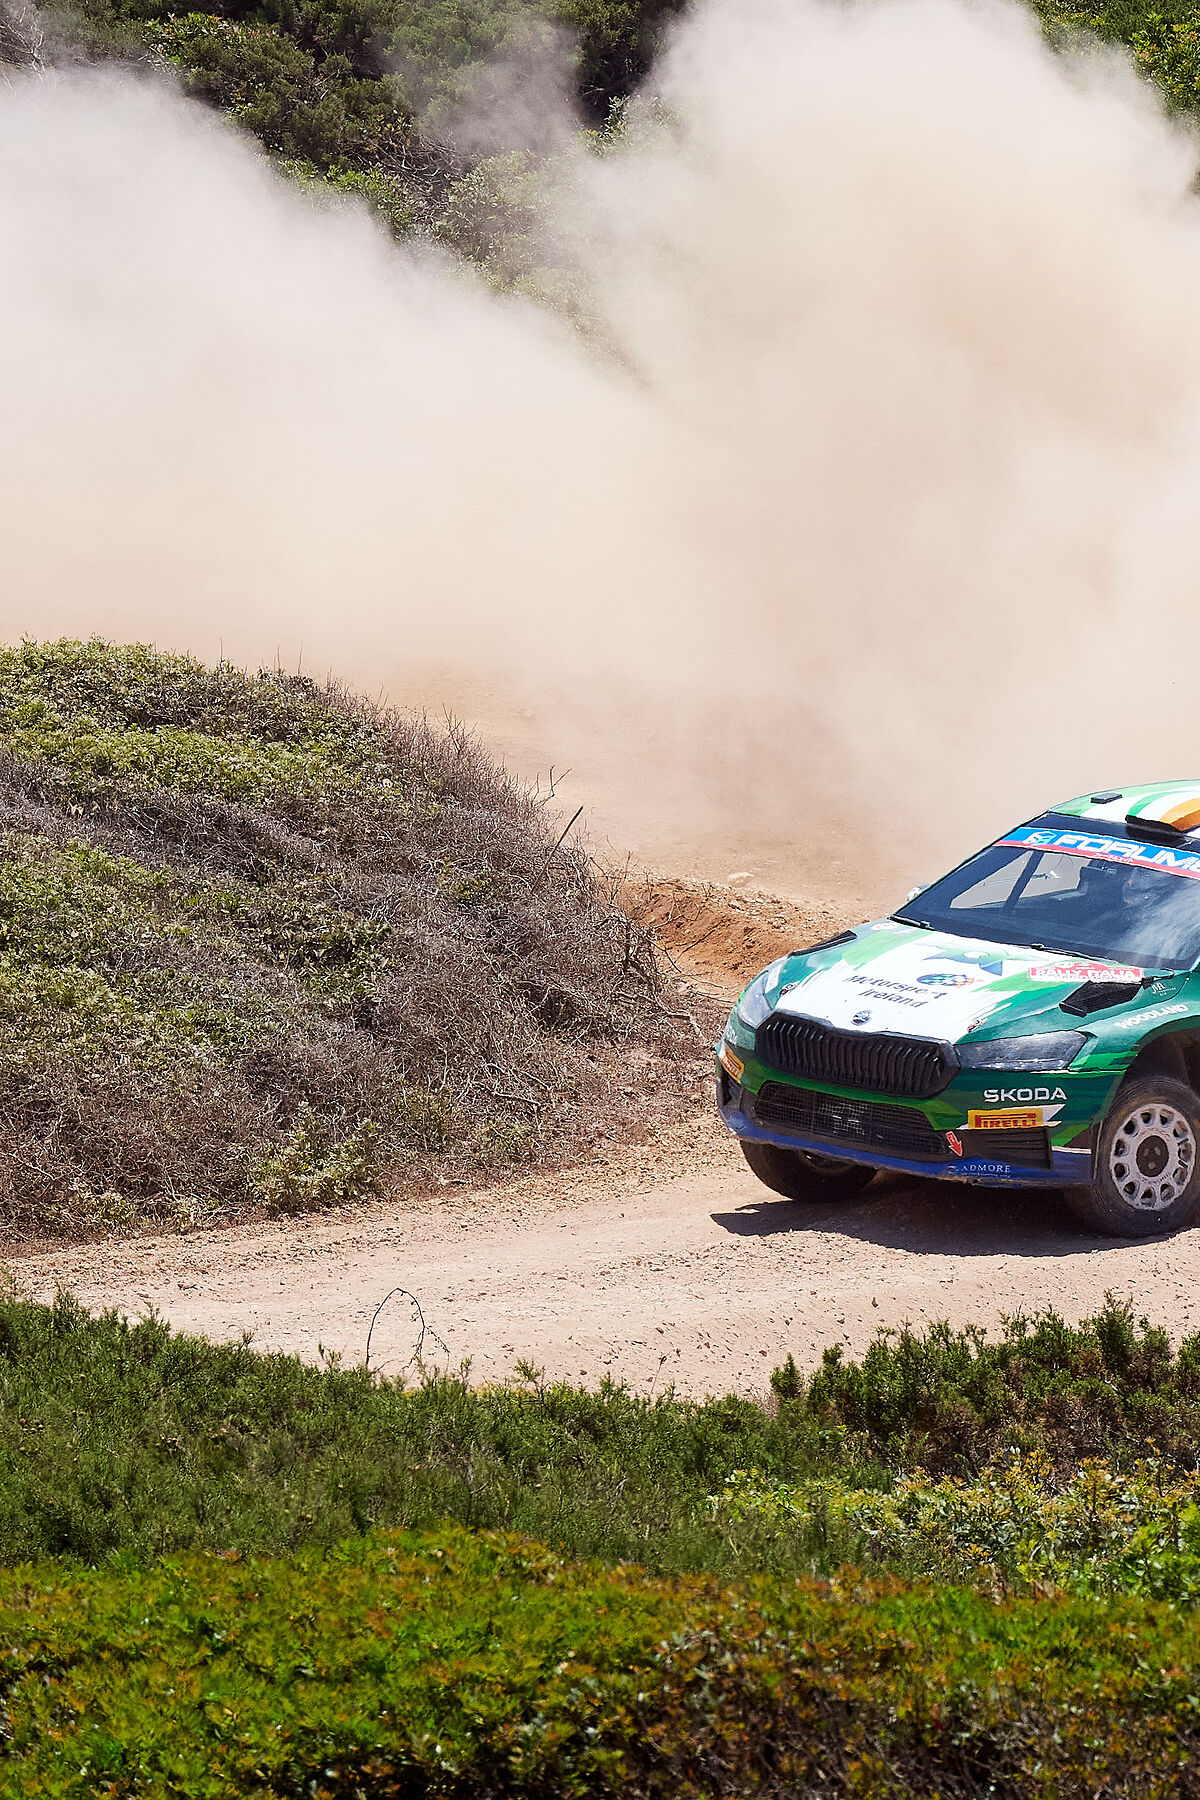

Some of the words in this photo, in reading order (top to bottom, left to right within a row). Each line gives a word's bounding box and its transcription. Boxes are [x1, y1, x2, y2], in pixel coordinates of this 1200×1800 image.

[1035, 968, 1083, 978] RALLY
[1087, 968, 1136, 980] ITALIA
[858, 988, 928, 1008] Ireland
[1113, 1004, 1189, 1029] WOODLAND
[983, 1087, 1067, 1103] SKODA
[974, 1112, 1037, 1128] PIRELLI
